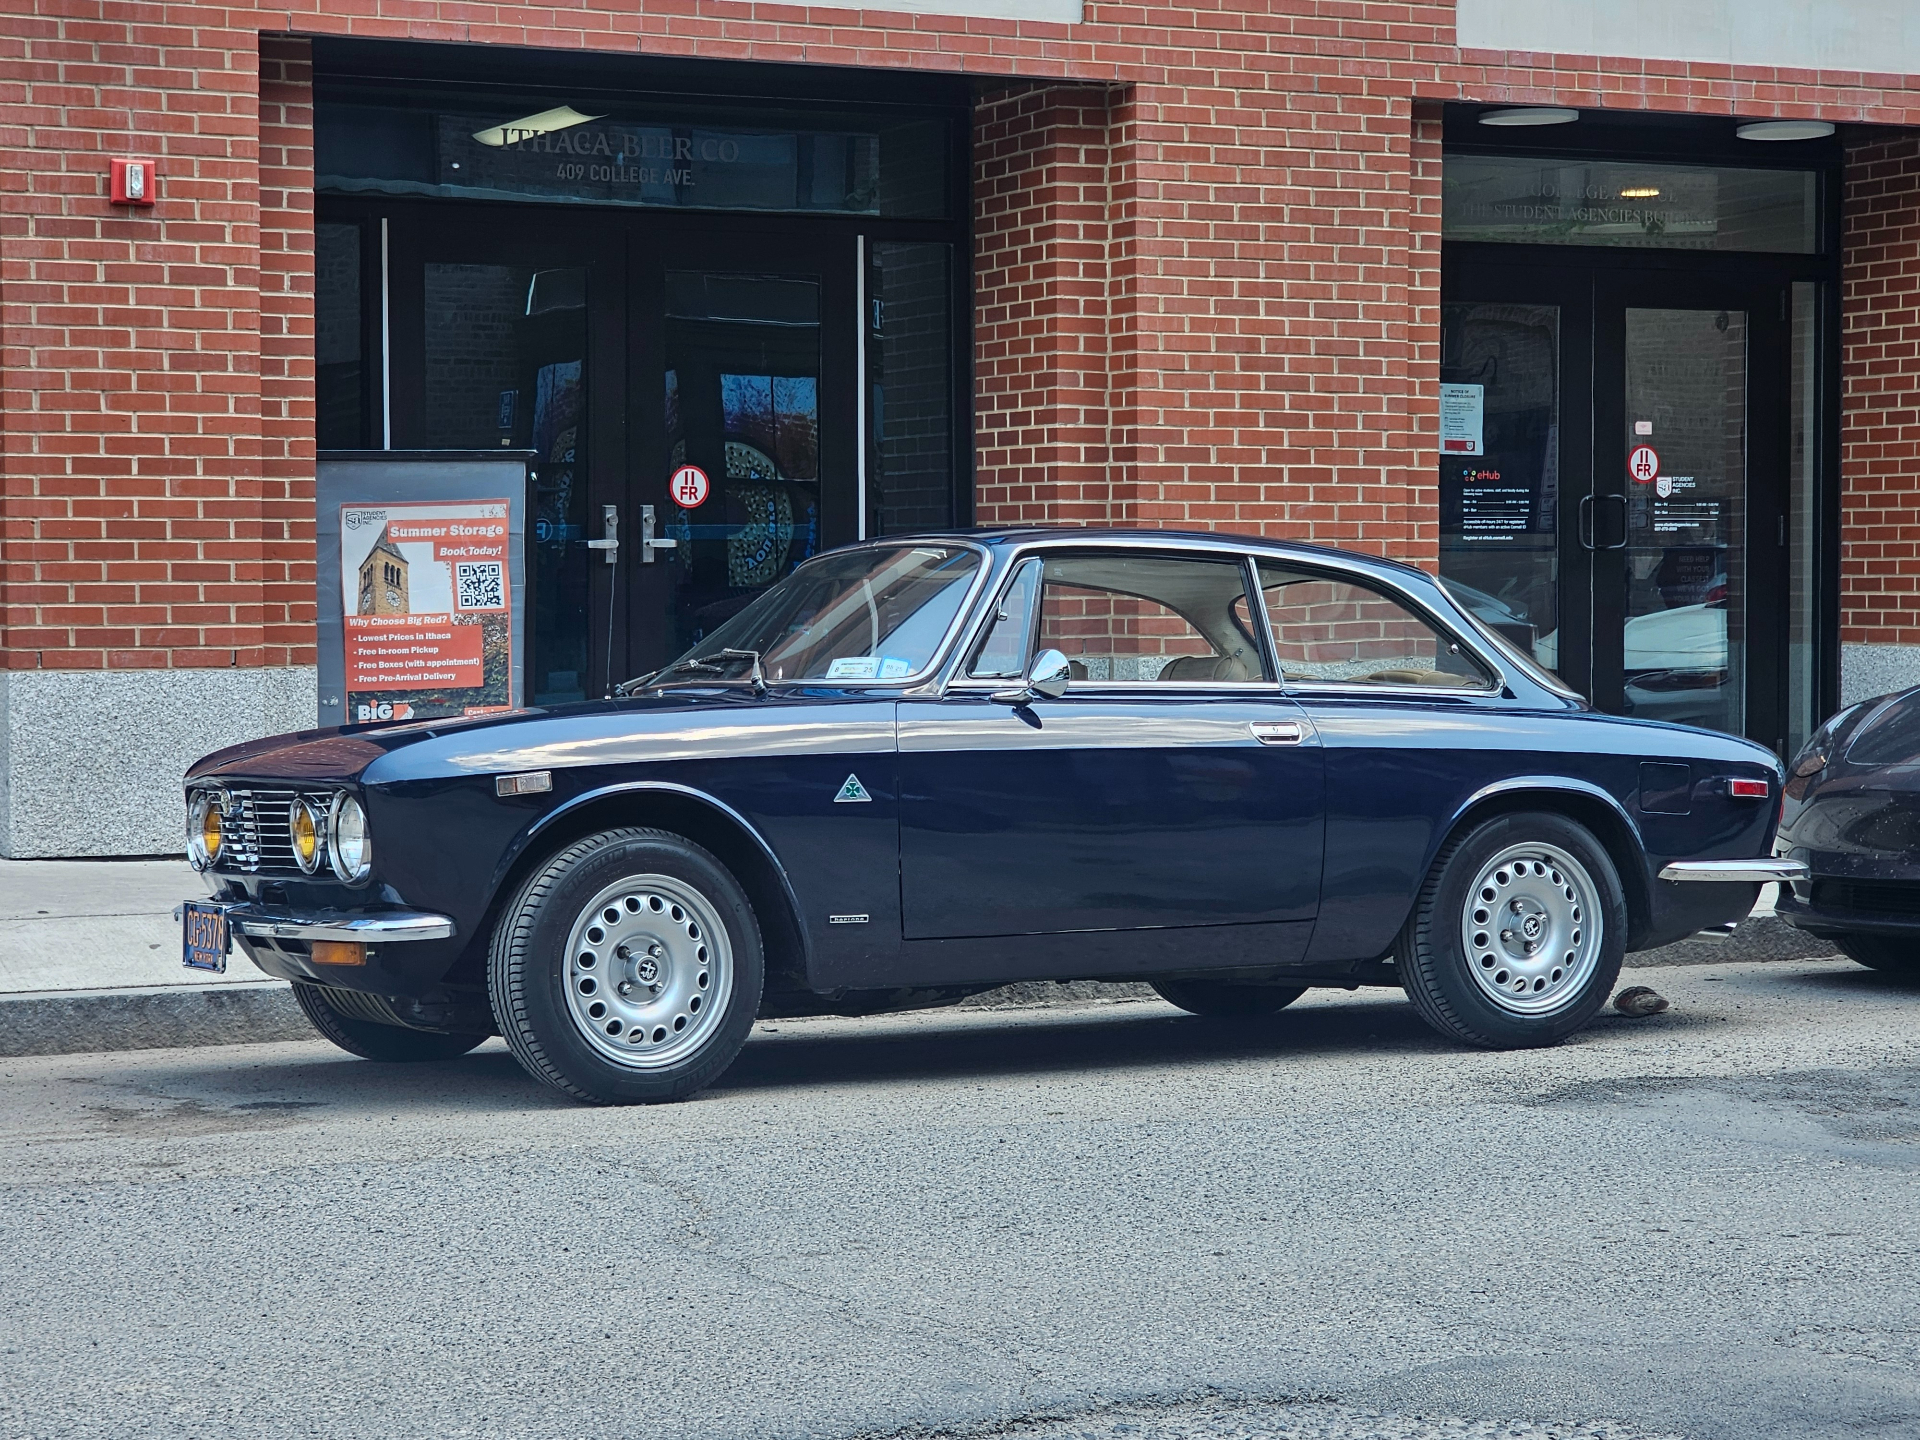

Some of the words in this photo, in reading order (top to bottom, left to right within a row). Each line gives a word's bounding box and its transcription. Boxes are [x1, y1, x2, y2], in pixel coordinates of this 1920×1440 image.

[501, 128, 613, 156] ITHACA
[623, 132, 693, 161] BEER
[700, 138, 740, 163] CO
[556, 164, 584, 181] 409
[590, 165, 658, 184] COLLEGE
[664, 168, 696, 186] AVE.
[1530, 184, 1608, 200] COLEGE
[1493, 204, 1564, 220] STUDENT
[1567, 207, 1641, 223] AGENCIES
[1477, 470, 1500, 480] eHub
[1637, 463, 1651, 477] FR
[680, 486, 698, 501] FR
[390, 525, 447, 537] Summer
[450, 524, 505, 538] Storage
[440, 547, 466, 557] Book
[468, 546, 502, 557] Today!
[1695, 555, 1710, 563] HELP
[349, 618, 369, 628] Why
[371, 617, 405, 626] Choose
[407, 617, 422, 626] Big
[424, 615, 447, 624] Red?
[358, 634, 387, 642] Lowest
[388, 633, 414, 641] Prices
[416, 632, 424, 640] in
[426, 632, 451, 640] Ithaca
[358, 648, 377, 656] Free
[378, 647, 409, 655] in-room
[411, 646, 439, 655] Pickup
[405, 660, 425, 669] (with
[427, 658, 480, 668] appointment)
[358, 675, 377, 683] Free
[379, 674, 421, 682] Pre-Arrival
[423, 673, 456, 682] Delivery
[564, 848, 625, 898] MICHELIN
[194, 951, 203, 962] NEW
[203, 952, 213, 963] YORK
